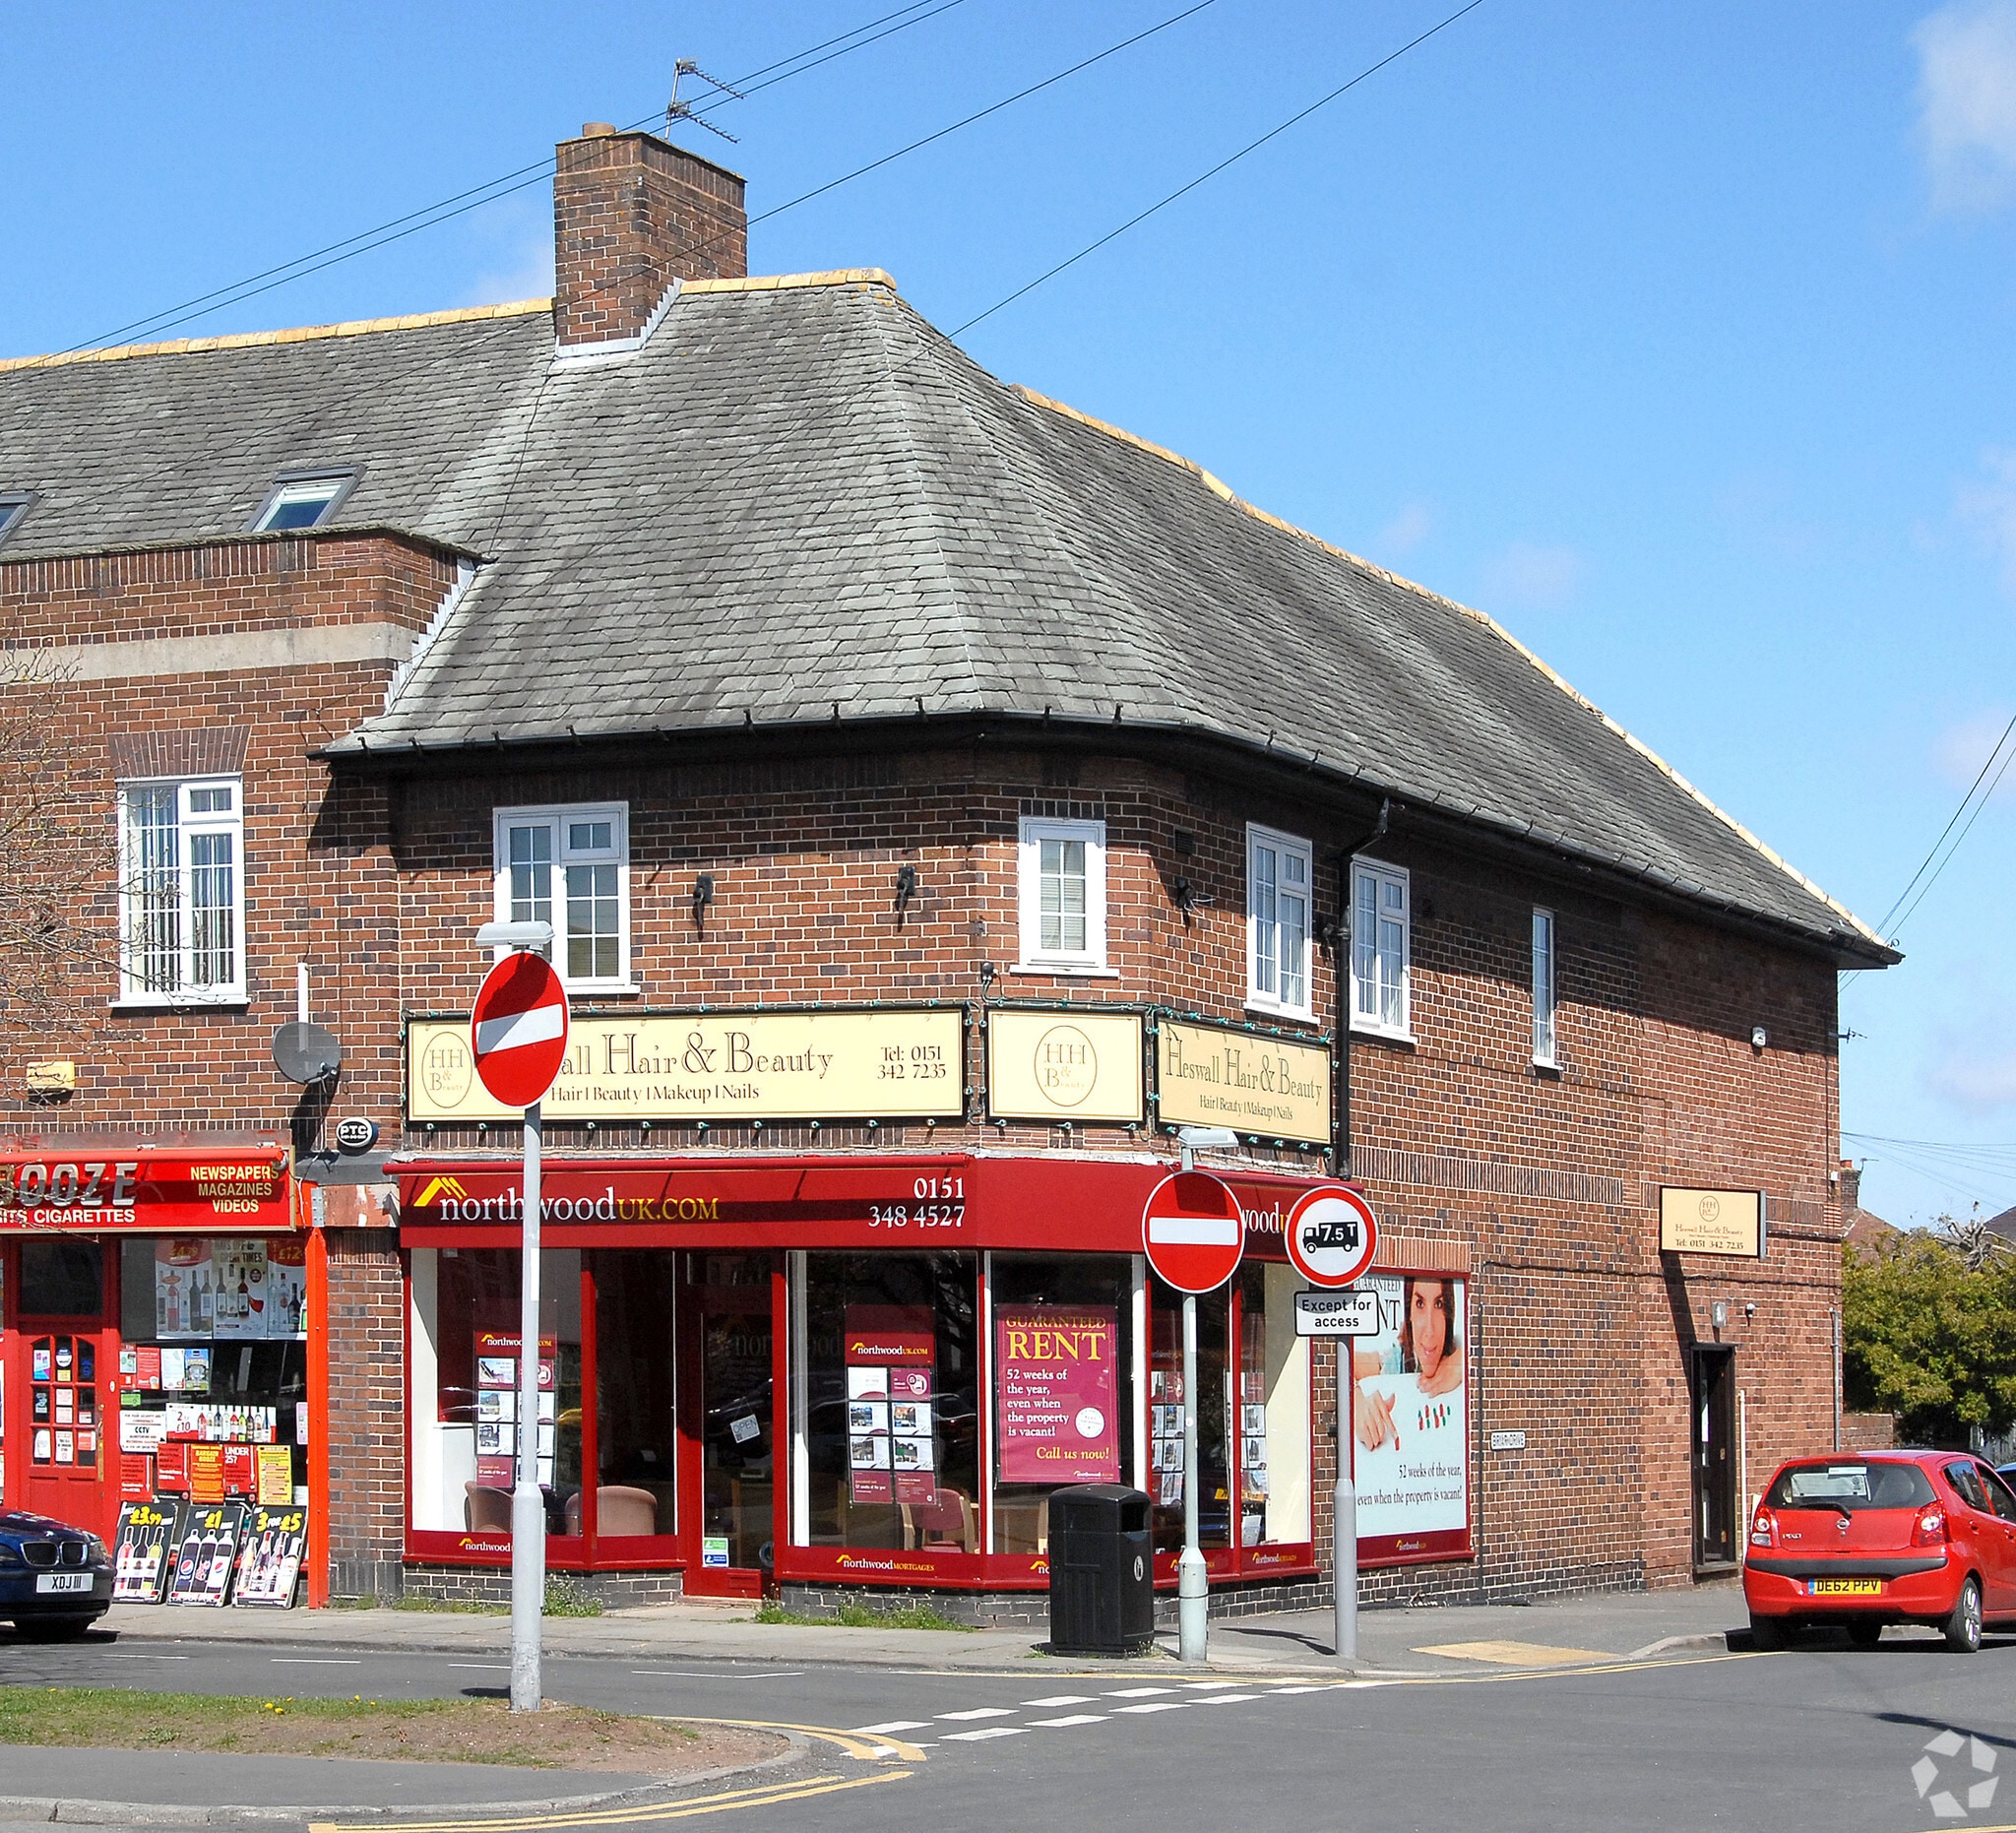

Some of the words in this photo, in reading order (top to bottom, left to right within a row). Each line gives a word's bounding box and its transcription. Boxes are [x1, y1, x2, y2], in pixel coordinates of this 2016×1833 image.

[429, 1049, 464, 1068] HH
[601, 1033, 678, 1075] Hair
[681, 1032, 718, 1074] &
[724, 1031, 834, 1080] Beauty
[881, 1045, 905, 1061] Tel:
[911, 1044, 942, 1061] 0151
[1043, 1043, 1086, 1065] HH
[877, 1063, 906, 1080] 342
[913, 1062, 947, 1080] 7235
[1166, 1037, 1221, 1084] Heswall
[1225, 1047, 1259, 1090] Hair
[1260, 1054, 1275, 1093] &
[1278, 1057, 1323, 1106] Beauty
[551, 1086, 583, 1101] Hair
[594, 1086, 643, 1105] Beauty
[653, 1084, 712, 1105] Makeup
[723, 1083, 760, 1100] Nails
[1199, 1094, 1216, 1108] Hair
[1220, 1097, 1243, 1116] Beauty
[1246, 1102, 1275, 1121] Makeup
[1277, 1106, 1293, 1120] Nails
[340, 1124, 368, 1135] PTC
[191, 1165, 280, 1180] NEWSPAPERS
[198, 1182, 273, 1196] MAGAZINES
[914, 1176, 965, 1199] 0151
[213, 1199, 260, 1214] VIDEOS
[33, 1209, 136, 1224] CIGARETTES
[868, 1205, 908, 1229] 348
[913, 1205, 966, 1229] 4527
[1675, 1238, 1687, 1247] Tel:
[1689, 1239, 1706, 1248] 0151
[1709, 1240, 1724, 1249] 342
[1727, 1241, 1744, 1250] 7235
[1302, 1298, 1348, 1313] Except
[1353, 1297, 1371, 1311] for
[1006, 1315, 1106, 1329] GUARANTEED
[1314, 1317, 1359, 1327] access
[1378, 1298, 1402, 1331] NT
[1006, 1330, 1107, 1360] RENT
[1006, 1368, 1021, 1380] 52
[1023, 1368, 1054, 1380] weeks
[1056, 1368, 1068, 1380] of
[1007, 1383, 1024, 1394] the
[1026, 1384, 1050, 1396] year,
[1007, 1399, 1032, 1409] even
[1033, 1397, 1061, 1409] when
[732, 1418, 757, 1434] OPEN
[1007, 1412, 1025, 1422] the
[1027, 1413, 1069, 1425] property
[1008, 1426, 1017, 1436] is
[1019, 1425, 1056, 1437] vacant!
[224, 1446, 249, 1456] UNDER
[1037, 1446, 1061, 1460] Call
[1063, 1449, 1078, 1460] us
[1081, 1447, 1110, 1460] now!
[1399, 1464, 1407, 1479] 52
[1408, 1462, 1427, 1478] weeks
[1427, 1462, 1435, 1478] of
[1436, 1462, 1446, 1477] the
[1447, 1465, 1463, 1479] year,
[1356, 1494, 1373, 1506] even
[1373, 1488, 1392, 1505] when
[1393, 1487, 1404, 1503] the
[1405, 1490, 1432, 1506] property
[1434, 1487, 1439, 1500] is
[1440, 1485, 1463, 1500] vacant!
[128, 1505, 162, 1525] £3.99
[204, 1509, 222, 1529] £1
[256, 1511, 269, 1533] 3
[279, 1512, 303, 1533] £5
[466, 1541, 513, 1552] northwood
[51, 1576, 72, 1589] XDJ
[1816, 1580, 1851, 1592] DE62
[1853, 1579, 1879, 1592] PPV
